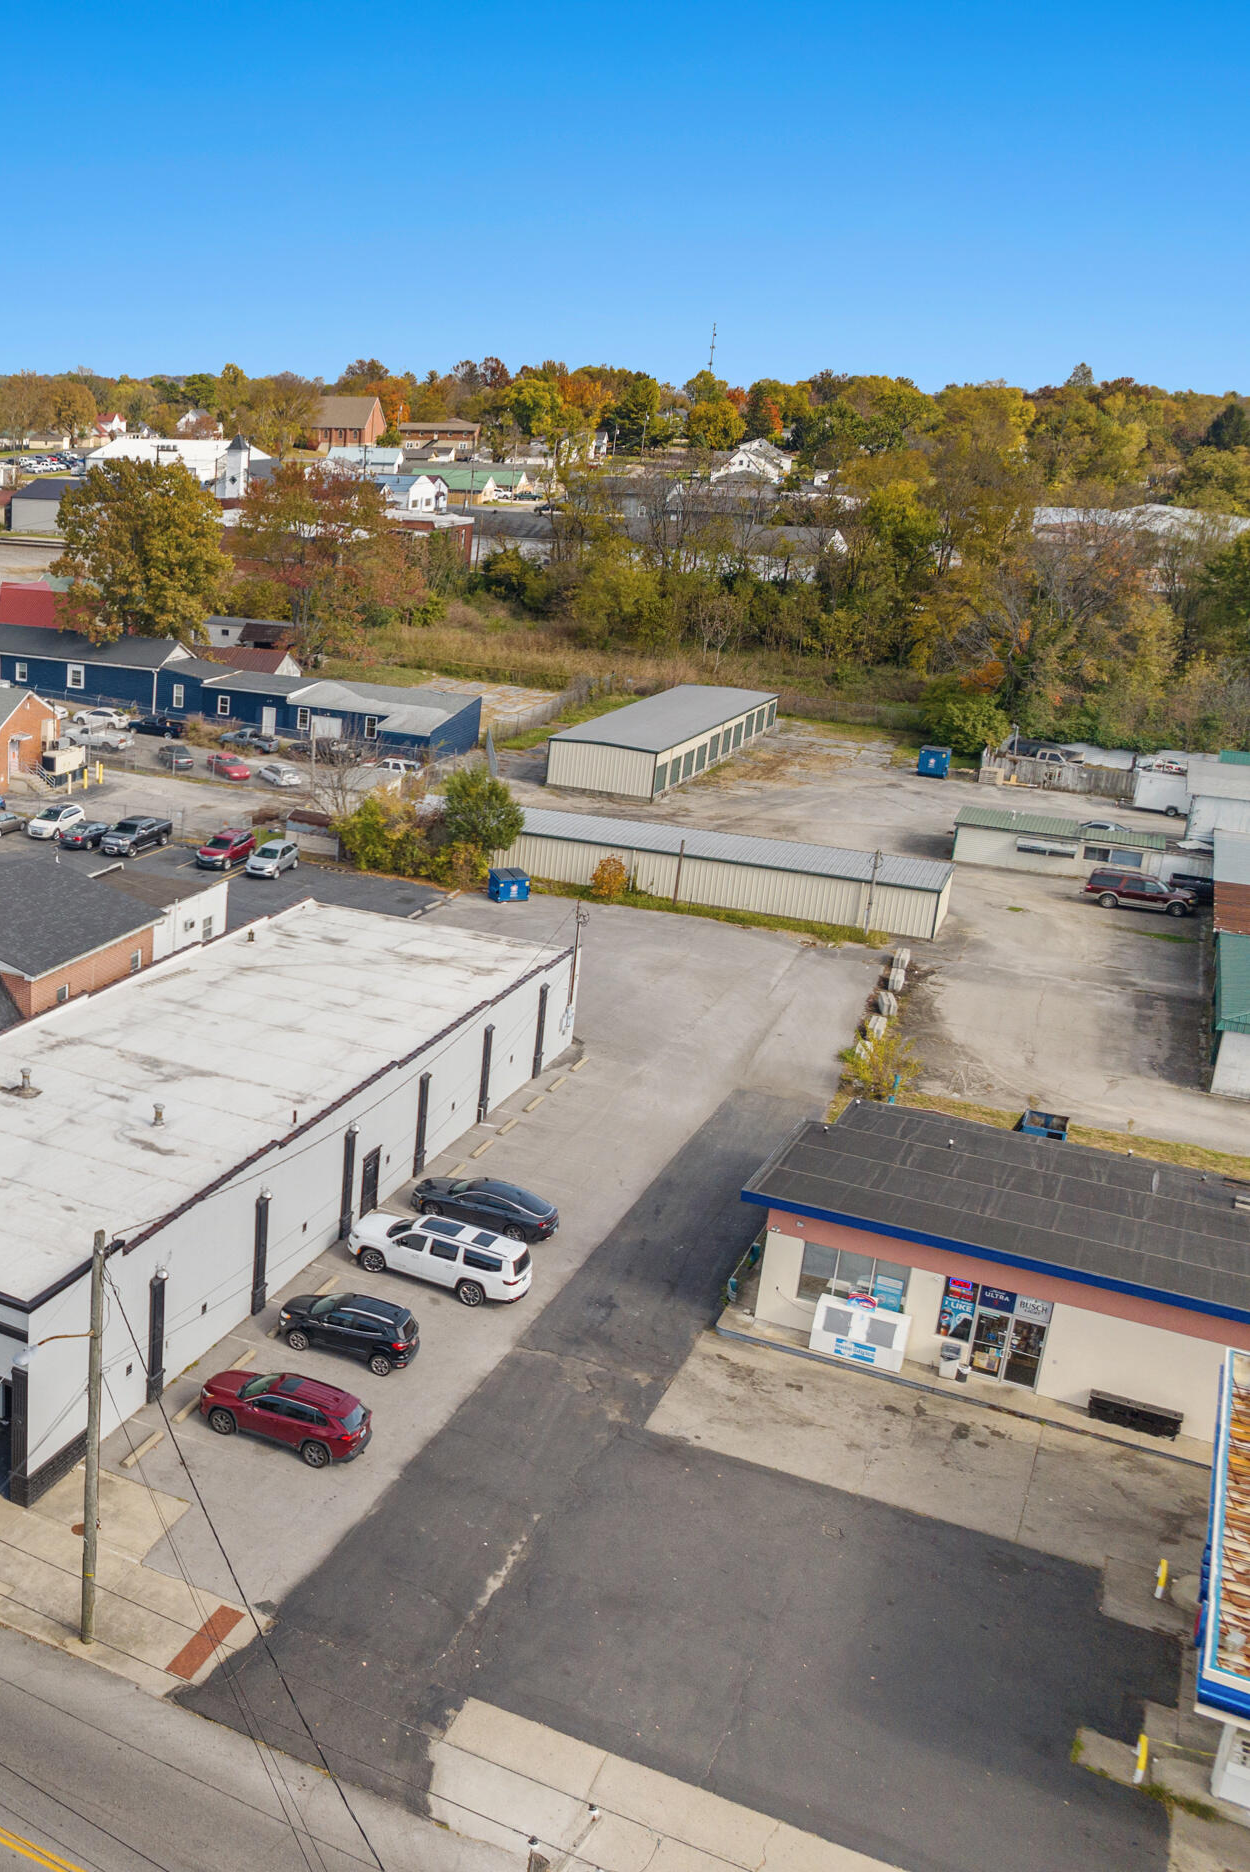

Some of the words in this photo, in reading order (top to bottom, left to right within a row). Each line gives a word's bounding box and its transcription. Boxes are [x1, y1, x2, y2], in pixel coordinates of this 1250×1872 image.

[951, 1279, 971, 1289] OPEN
[985, 1291, 1010, 1302] ULTRA
[951, 1301, 973, 1312] LIKE
[1019, 1300, 1048, 1313] BUSCH
